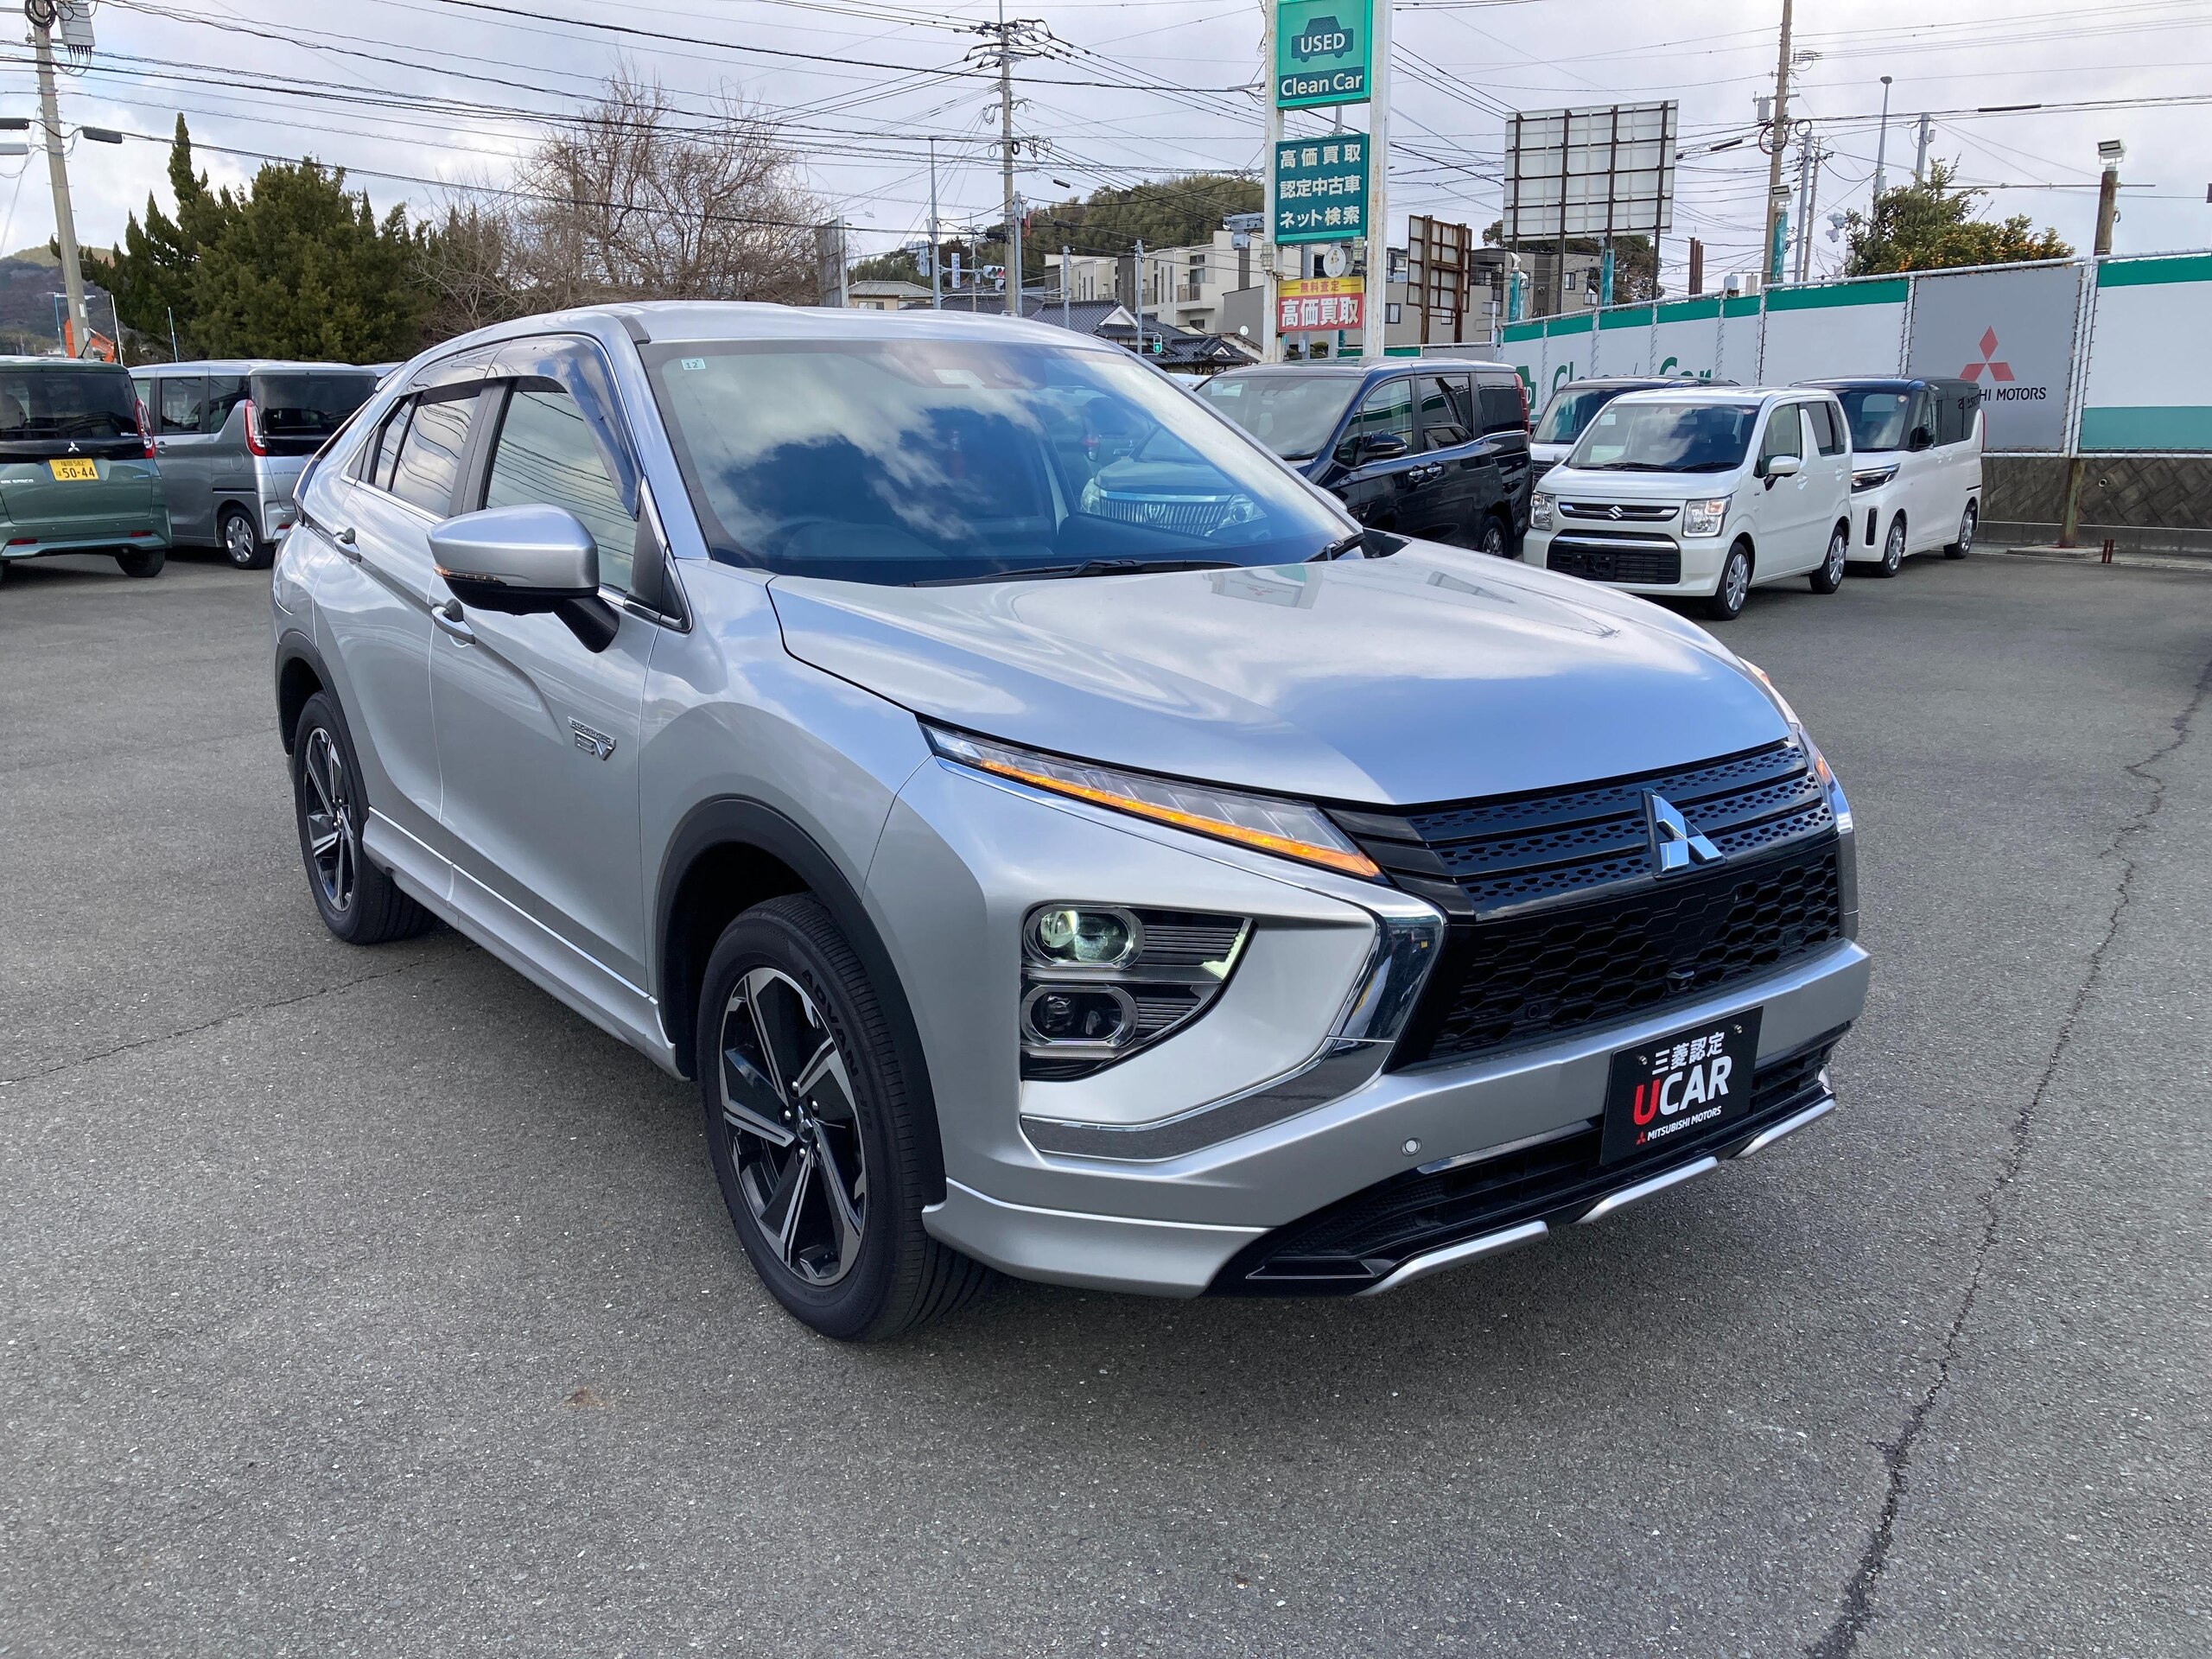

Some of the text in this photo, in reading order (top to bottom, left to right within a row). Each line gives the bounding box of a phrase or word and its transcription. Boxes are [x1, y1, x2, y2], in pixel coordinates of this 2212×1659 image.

[1300, 33, 1345, 54] USED
[1281, 73, 1363, 97] Clean Car
[1280, 143, 1361, 169] 高価買取
[1280, 175, 1362, 200] 認定中古車
[1280, 206, 1360, 229] ネット検索
[1300, 280, 1339, 293] 無料査定
[1281, 296, 1359, 327] 高価買取
[1997, 387, 2046, 401] MOTORS
[62, 467, 95, 478] 50-44
[802, 969, 859, 1077] ADVAN
[1651, 1032, 1725, 1076] 三菱認定
[1633, 1055, 1732, 1126] UCAR
[1647, 1106, 1722, 1141] MITSUBISHI MOTORS
